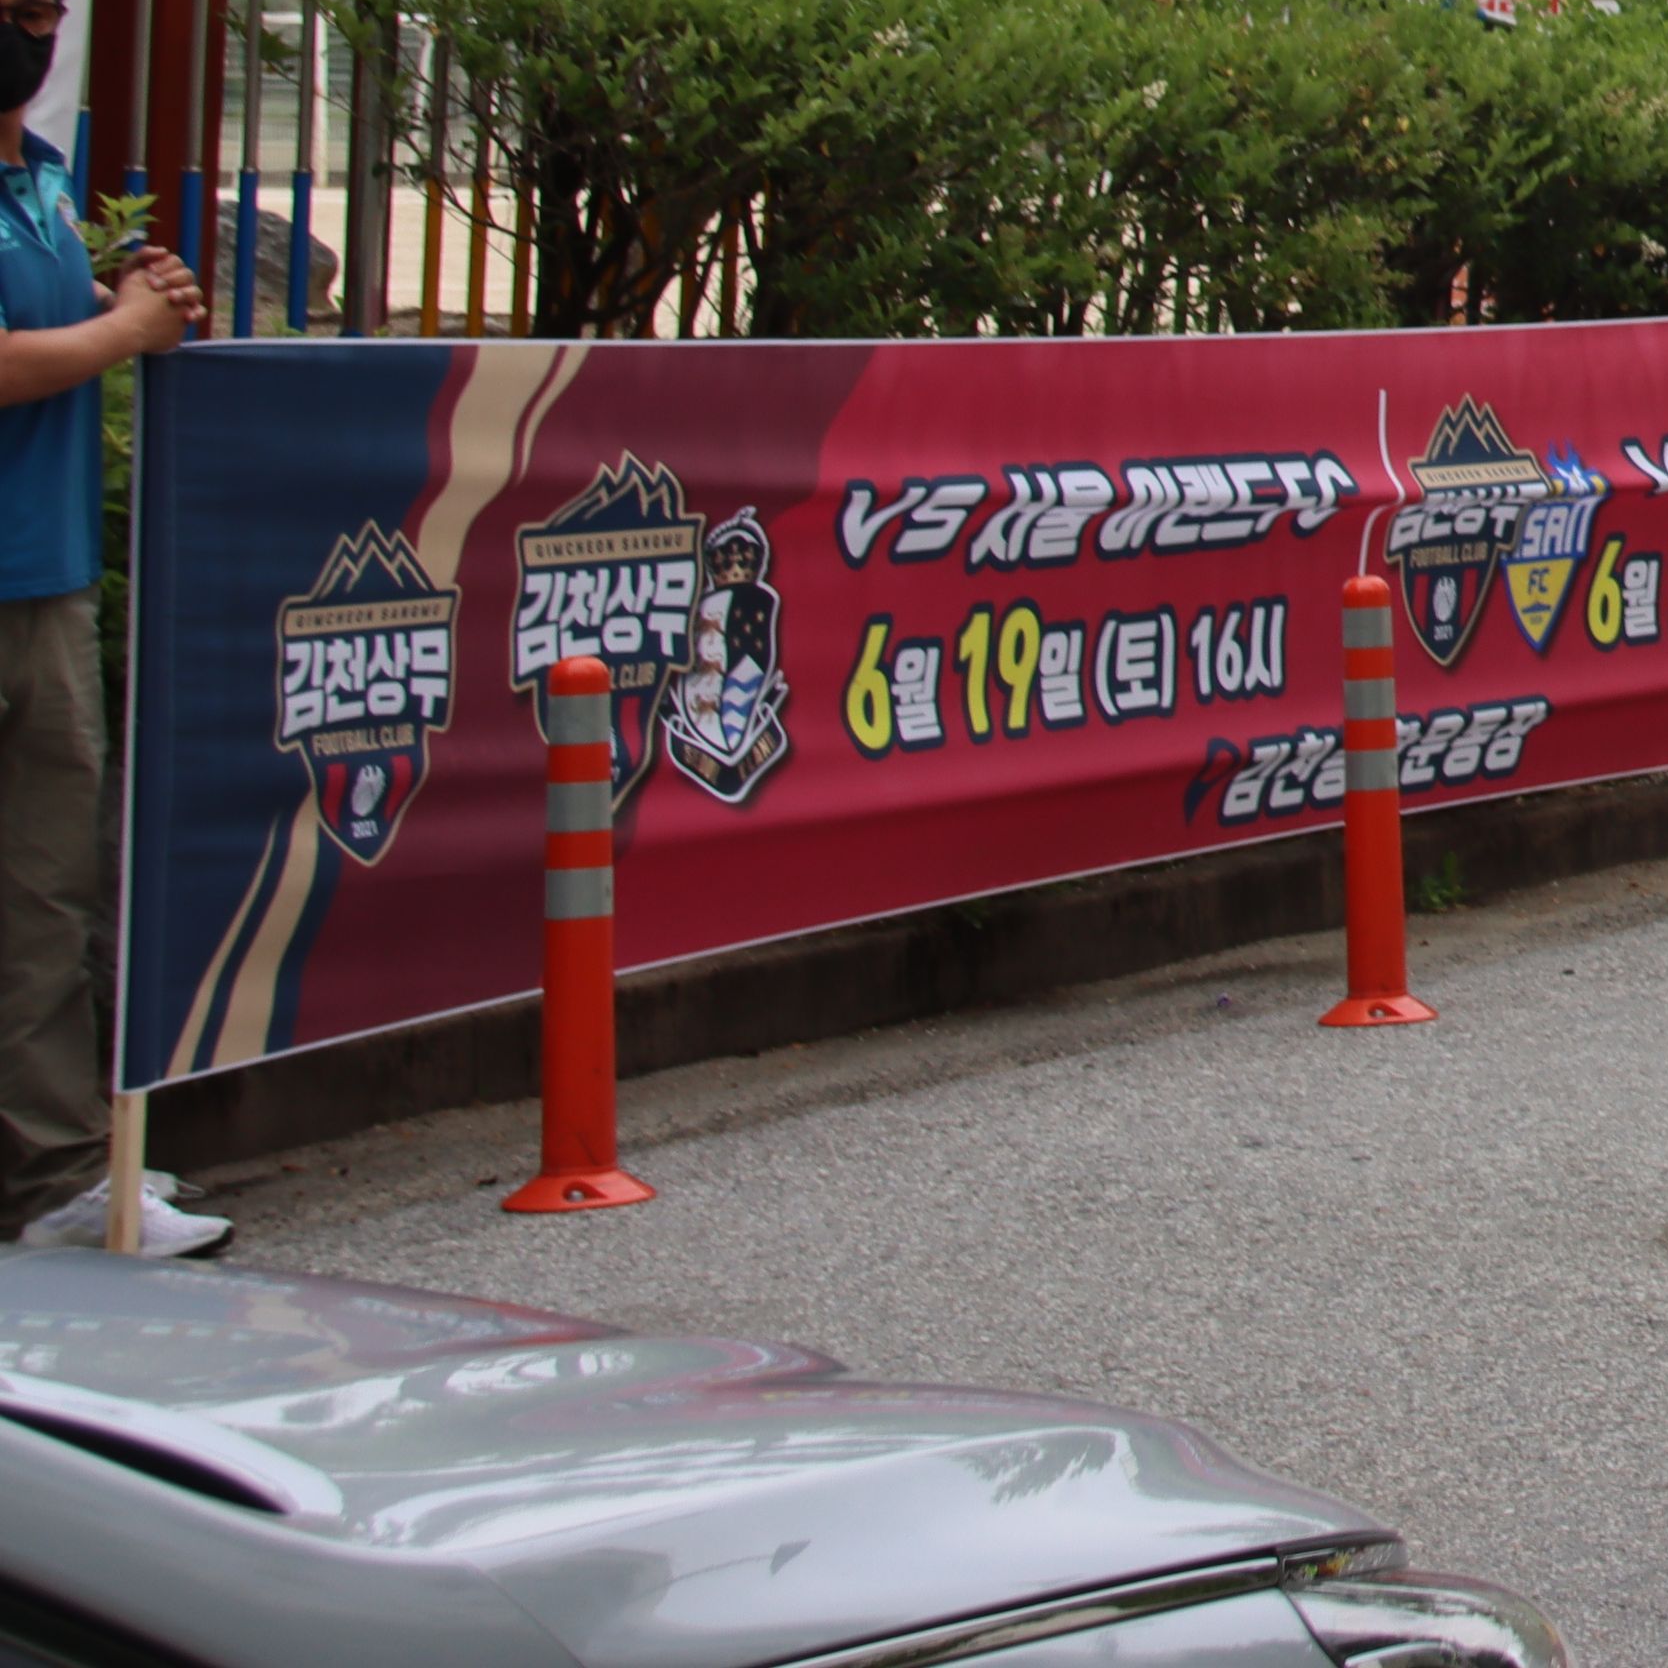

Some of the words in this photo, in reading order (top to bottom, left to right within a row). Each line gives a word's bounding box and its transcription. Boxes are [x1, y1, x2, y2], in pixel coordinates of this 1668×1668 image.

[843, 483, 985, 559] VS
[972, 469, 1115, 565] 서울
[516, 560, 697, 677] 김천상무
[1528, 568, 1551, 594] FC
[1588, 540, 1659, 644] 6월
[282, 629, 449, 738] 김천상무
[846, 623, 943, 751] 6월
[1191, 604, 1286, 695] 16시
[312, 727, 380, 756] FOOTBALL
[380, 723, 416, 748] CLUB
[1222, 701, 1547, 817] 김천종운동장
